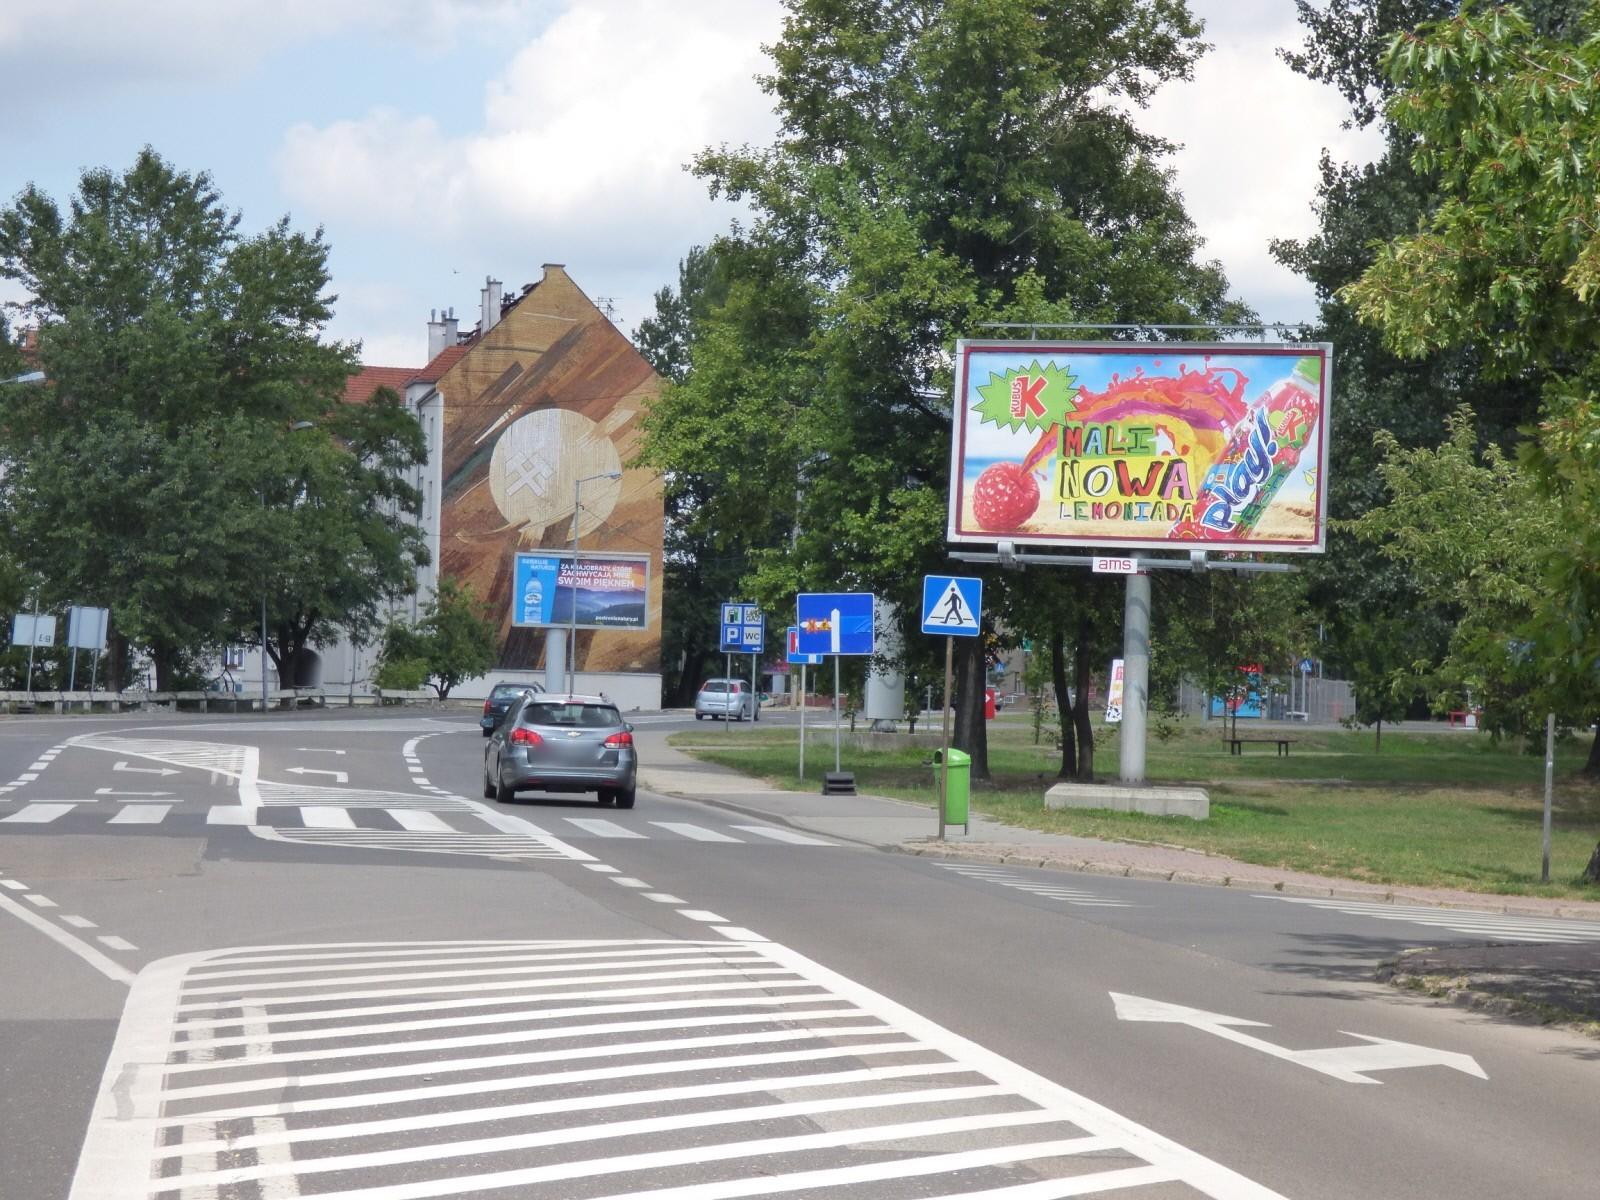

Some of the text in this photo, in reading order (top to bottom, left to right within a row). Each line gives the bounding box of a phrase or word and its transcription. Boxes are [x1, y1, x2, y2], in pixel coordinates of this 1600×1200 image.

[1062, 425, 1153, 457] MALI
[1060, 458, 1193, 500] NOWA
[1060, 501, 1194, 522] LEMONIADA
[1099, 559, 1132, 570] ams
[727, 627, 738, 643] P
[745, 632, 760, 641] WC
